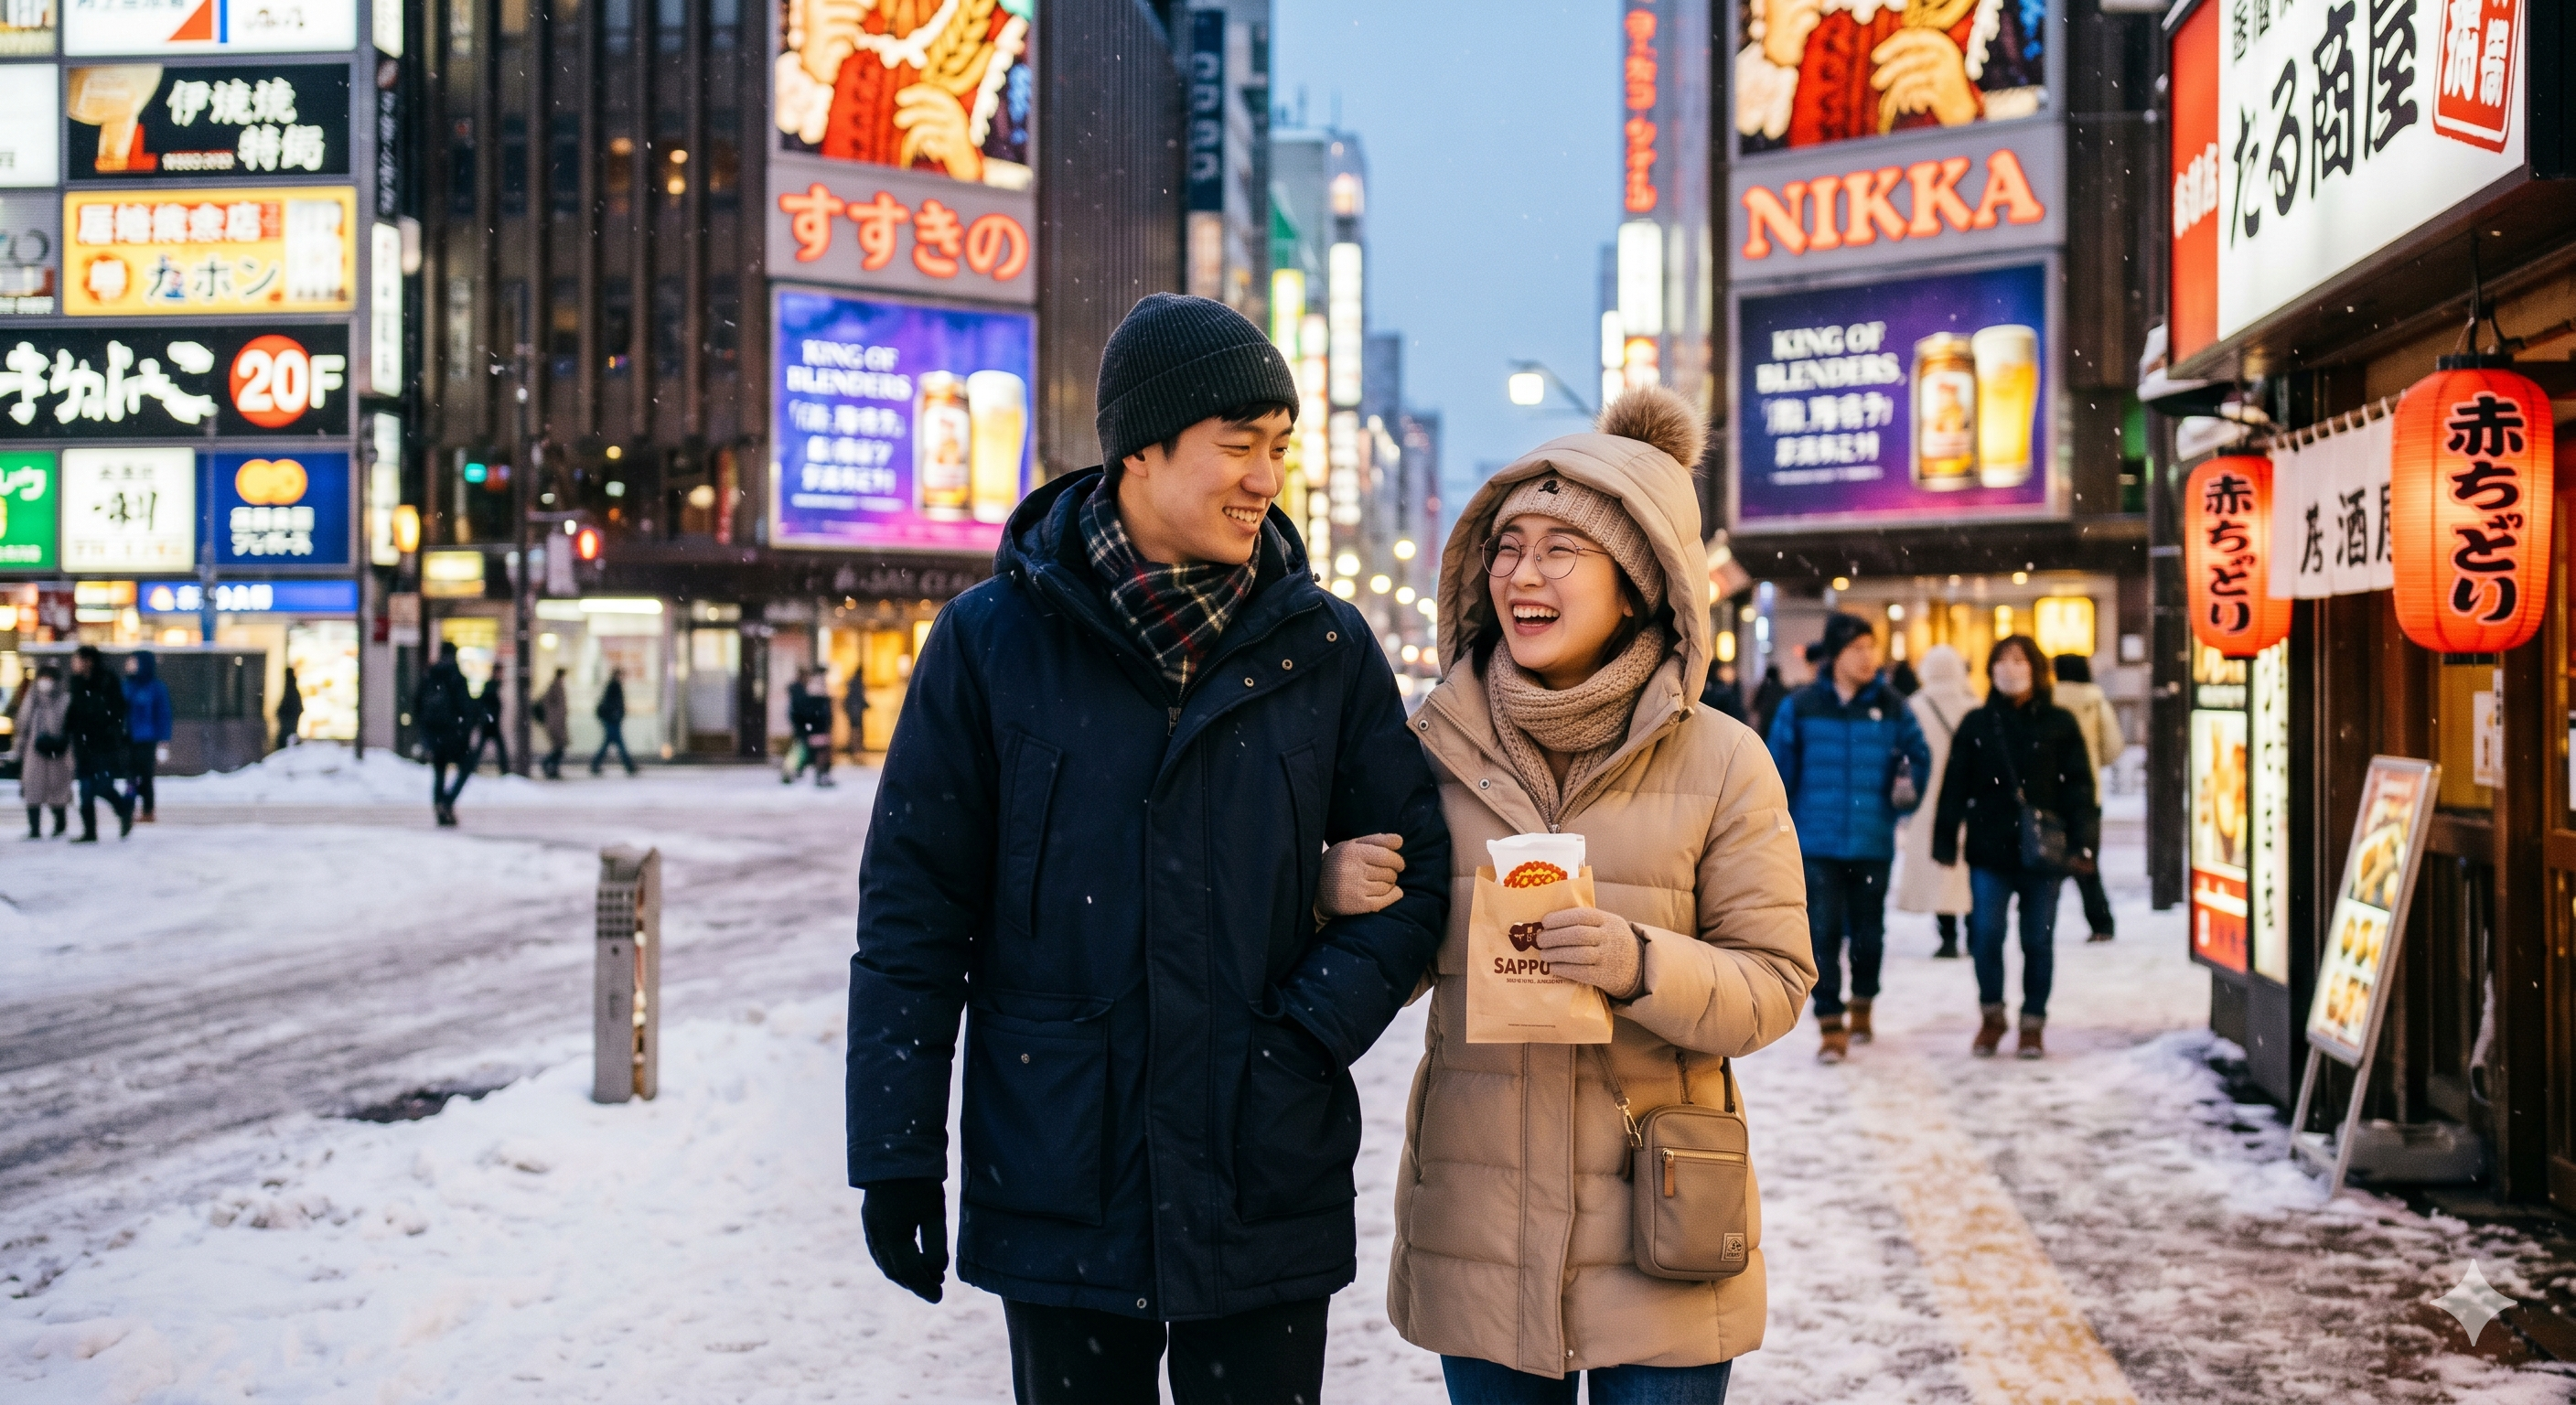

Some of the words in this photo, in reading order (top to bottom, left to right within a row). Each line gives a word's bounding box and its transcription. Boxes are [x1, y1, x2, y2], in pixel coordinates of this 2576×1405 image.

[778, 182, 1030, 281] すすきの
[1742, 148, 2045, 260] NIKKA
[235, 349, 347, 413] 20F
[1771, 326, 1845, 361] KING
[1845, 320, 1887, 354] OF
[2206, 475, 2256, 632] 赤ちどり
[2448, 395, 2524, 621] 赤ちどり
